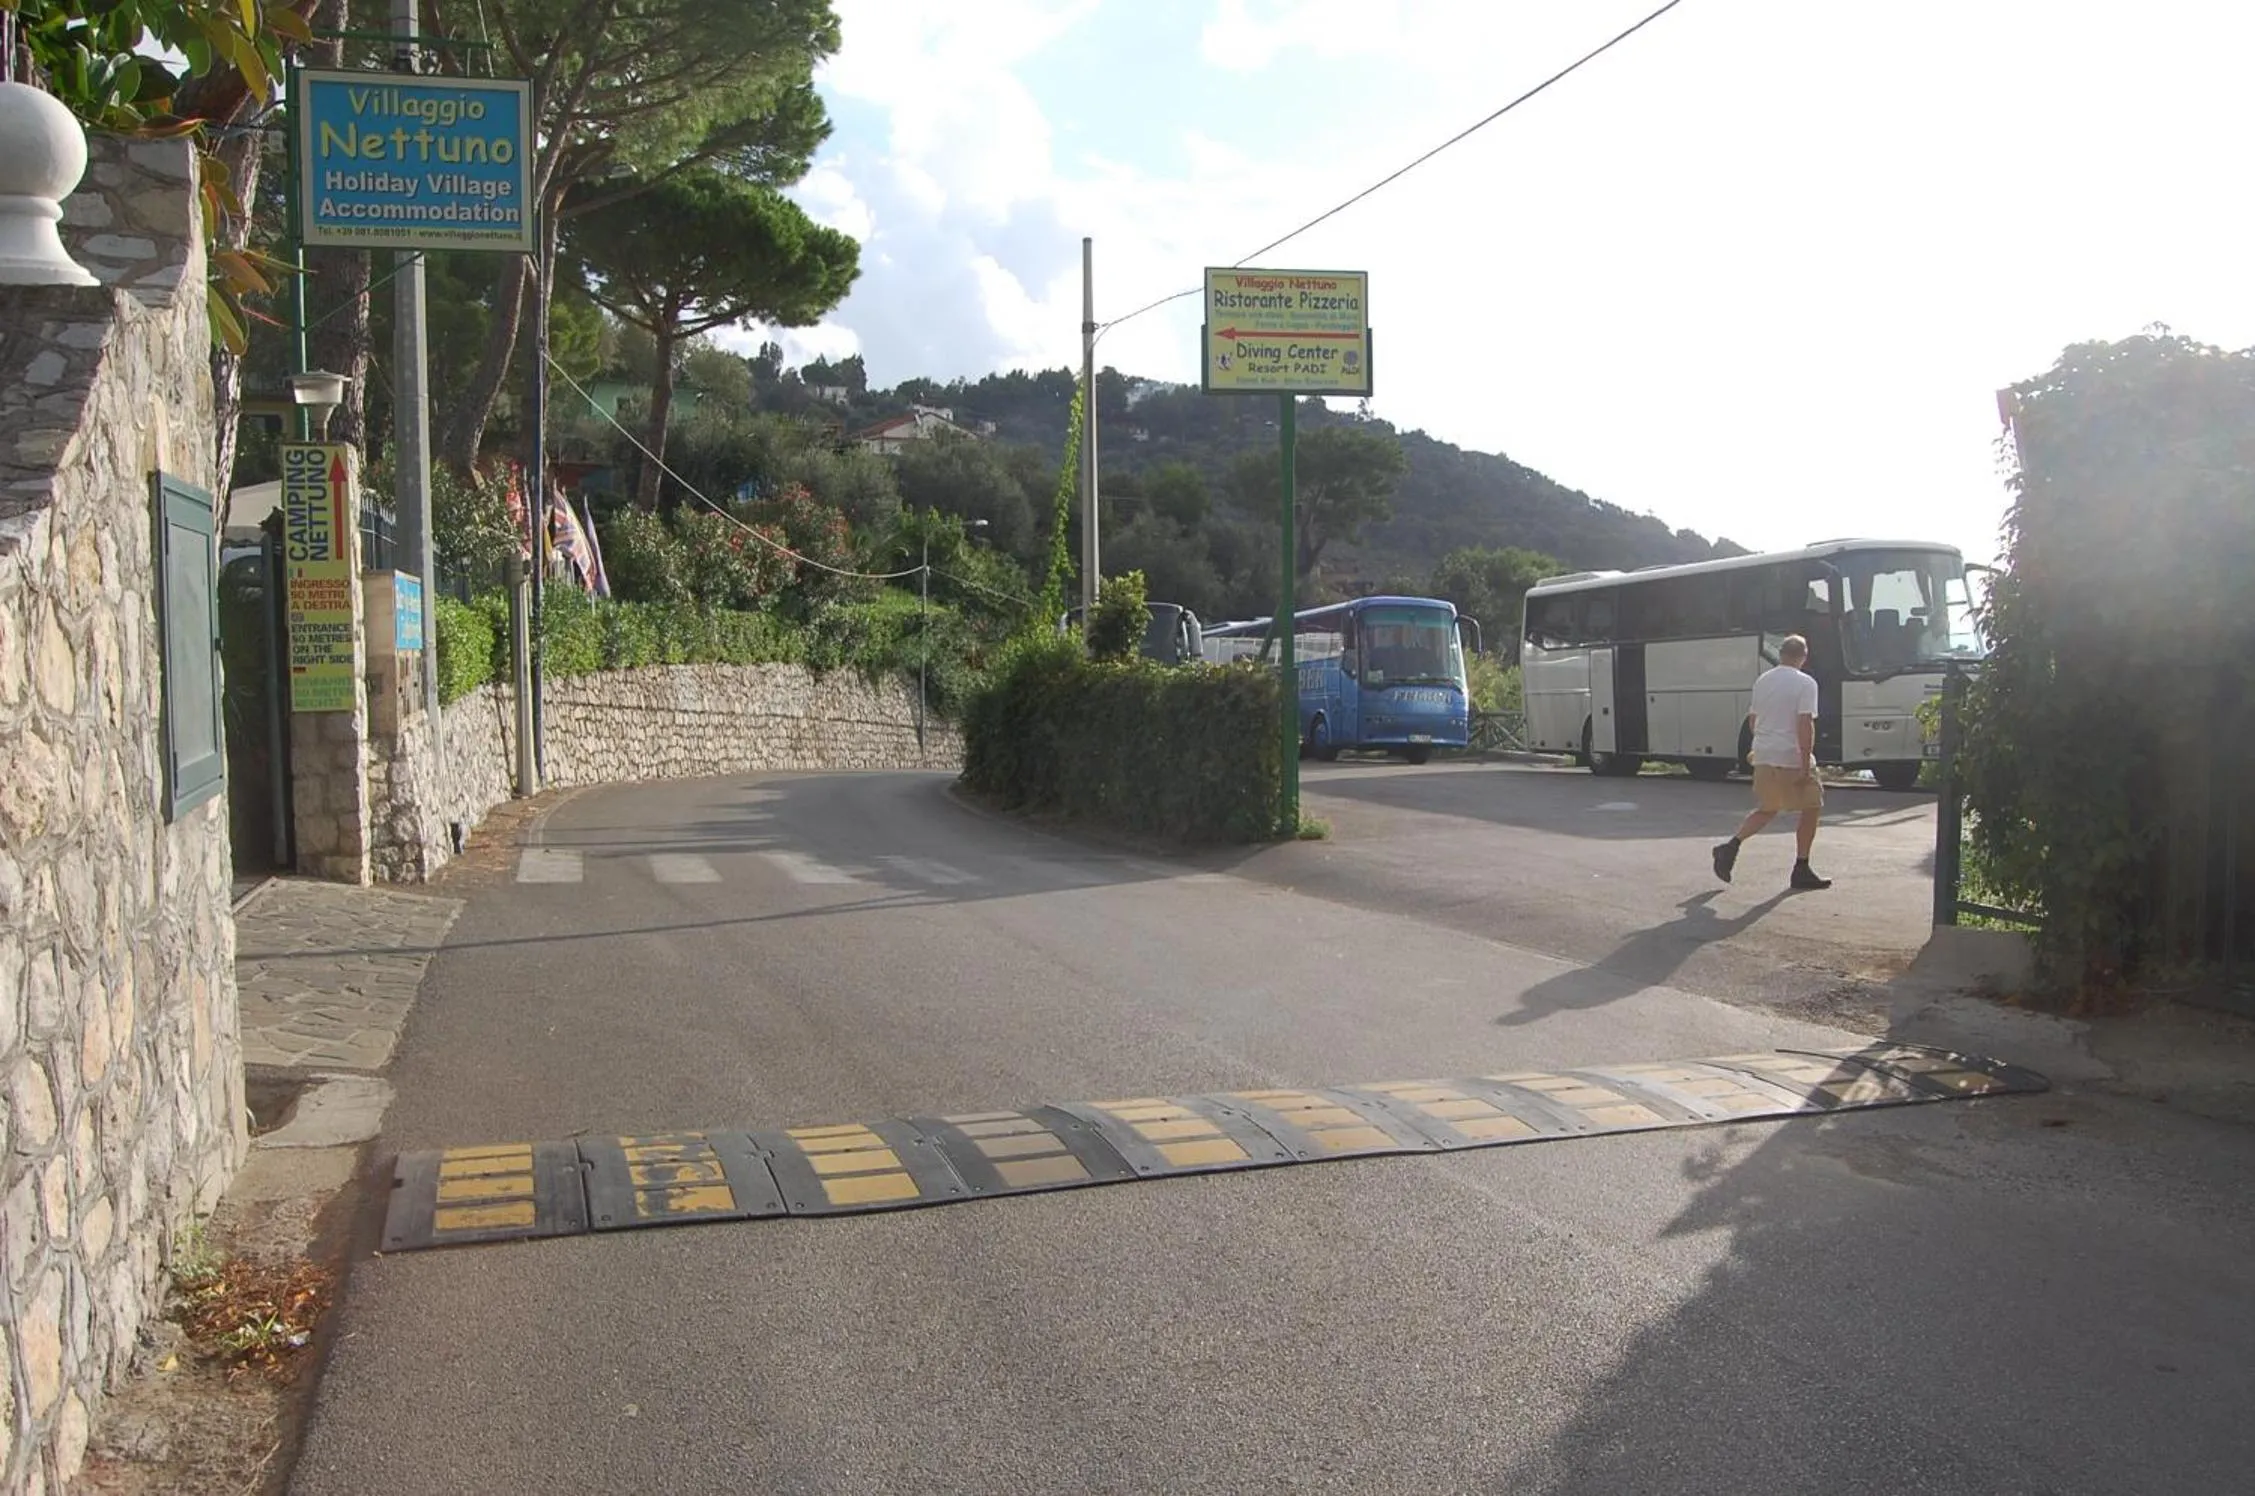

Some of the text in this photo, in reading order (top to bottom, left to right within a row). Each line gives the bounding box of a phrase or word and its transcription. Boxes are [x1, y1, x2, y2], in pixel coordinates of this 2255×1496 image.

[349, 87, 485, 126] Villaggio
[319, 120, 515, 164] Nettuno
[325, 170, 512, 199] Holiday Village
[319, 198, 520, 222] Accommodation
[1235, 276, 1337, 292] Villaggio Nettuno
[1213, 289, 1359, 310] Ristorante Pizzeria
[1236, 342, 1338, 363] Diving Center
[1248, 362, 1328, 374] Resort PADI
[286, 449, 308, 561] CAMPING
[307, 449, 329, 562] NETTUNO
[290, 578, 351, 589] INGRESSO
[308, 590, 345, 599] METRI
[292, 601, 351, 610] A DESTRA
[291, 623, 351, 633] ENTRANCE
[309, 633, 353, 643] METRES
[293, 644, 332, 654] ON THE
[293, 655, 355, 665] RIGHT SIDE
